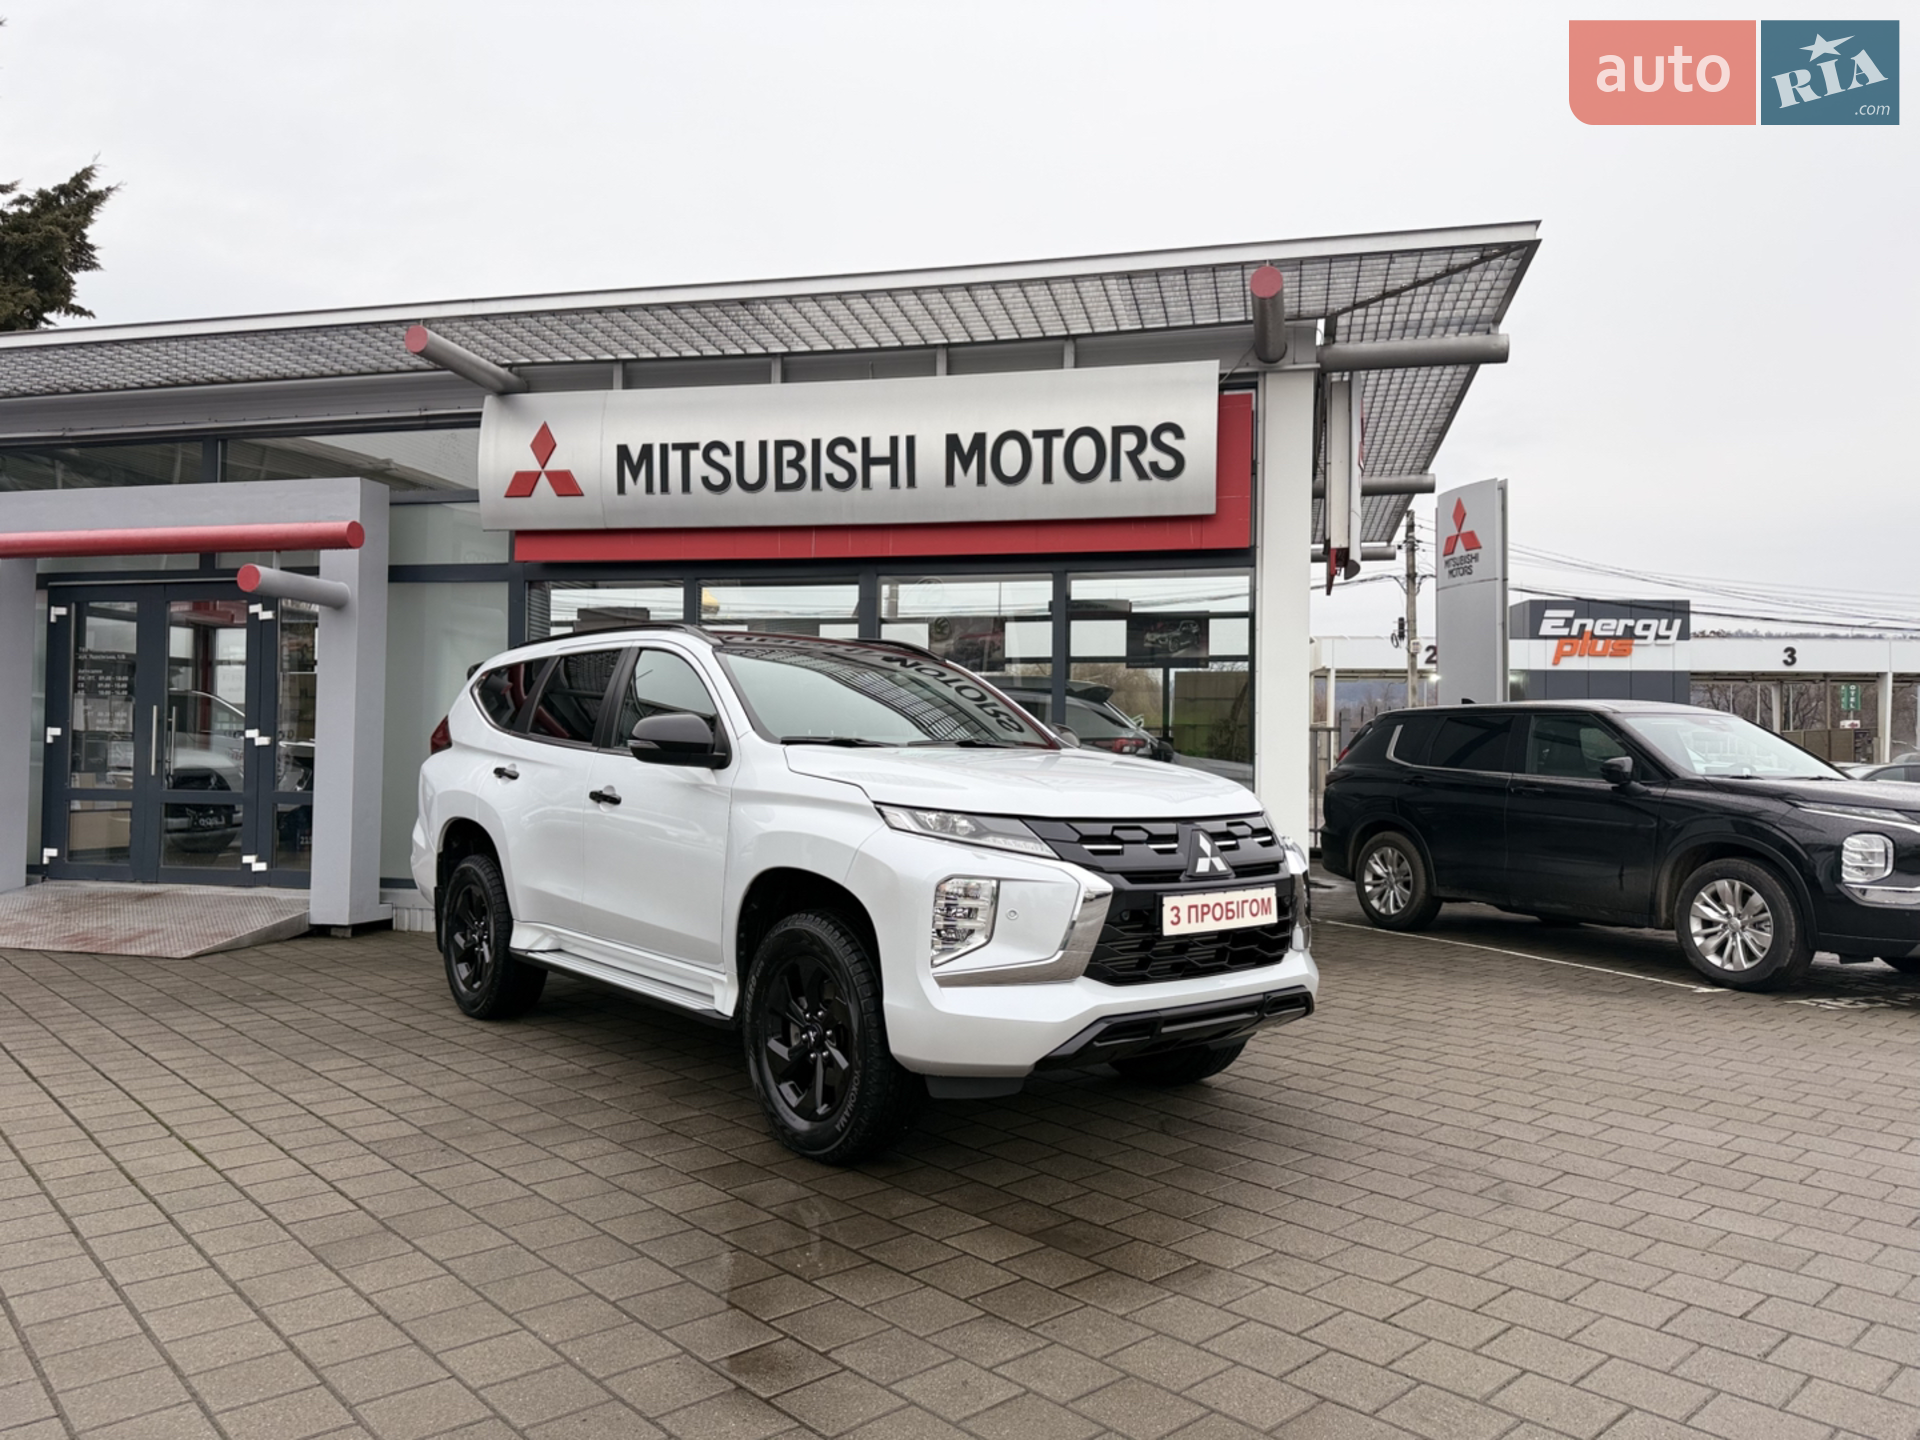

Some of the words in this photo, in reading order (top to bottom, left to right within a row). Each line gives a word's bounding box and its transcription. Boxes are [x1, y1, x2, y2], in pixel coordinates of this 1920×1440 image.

[615, 434, 917, 496] MITSUBISHI
[945, 421, 1186, 488] MOTORS
[1444, 552, 1480, 569] MITSUBISHI
[1448, 565, 1474, 579] MOTORS
[1538, 609, 1682, 646] Energy
[1424, 645, 1437, 664] 2
[1552, 630, 1635, 666] plus
[1782, 646, 1798, 667] 3
[1187, 896, 1273, 924] ПРОБІГОМ
[834, 1069, 862, 1133] YOKOHAMA
